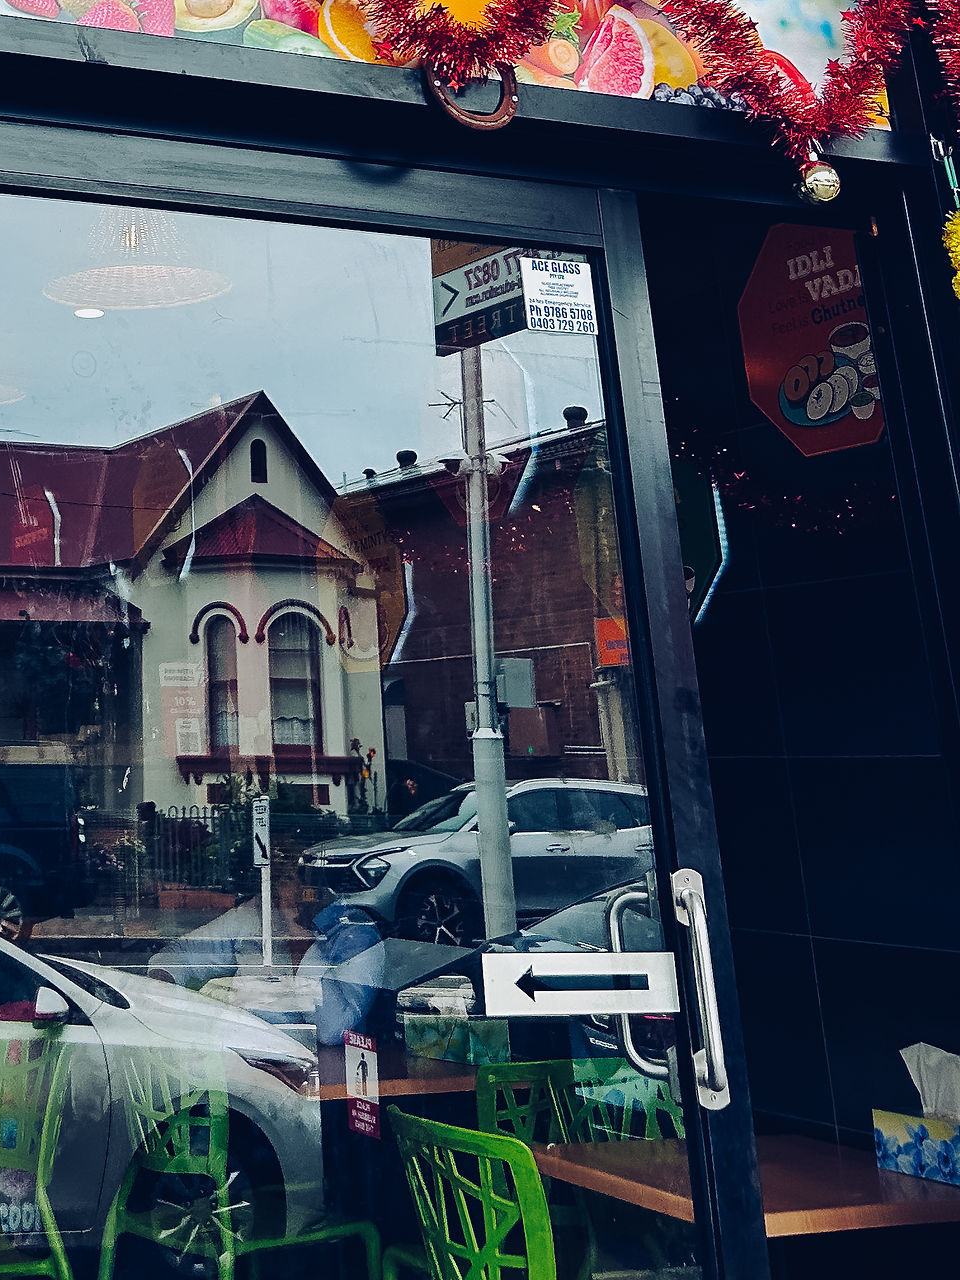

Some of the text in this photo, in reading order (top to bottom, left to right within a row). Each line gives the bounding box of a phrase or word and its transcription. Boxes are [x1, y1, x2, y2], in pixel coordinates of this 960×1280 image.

[531, 260, 581, 275] ACE GLASS
[786, 244, 835, 281] IDLI
[529, 305, 593, 321] Ph 9786 5708
[530, 317, 595, 333] 0403 729 260
